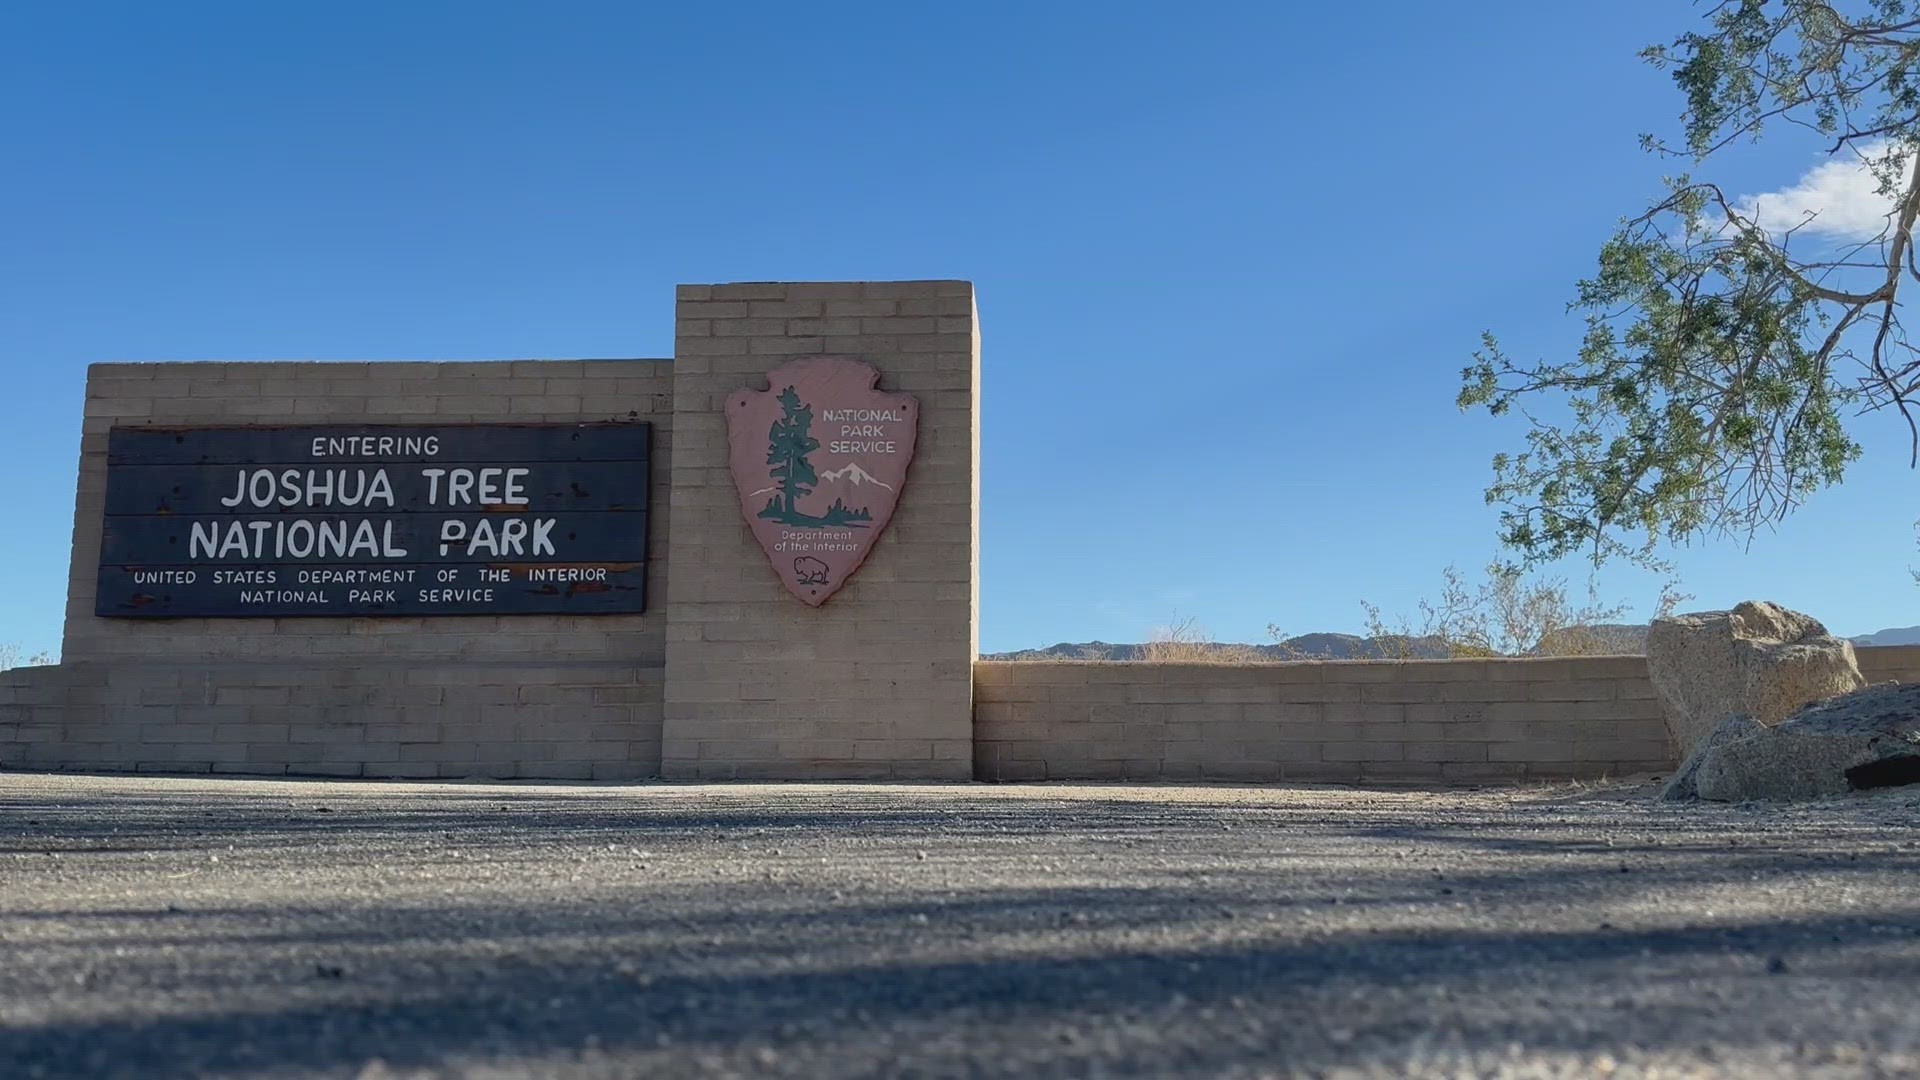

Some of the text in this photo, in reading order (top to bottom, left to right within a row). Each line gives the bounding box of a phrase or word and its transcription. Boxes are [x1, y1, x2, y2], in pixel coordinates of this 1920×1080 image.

[823, 410, 902, 421] NATIONAL
[841, 426, 884, 436] PARK
[311, 436, 439, 456] ENTERING
[830, 441, 896, 453] SERVICE
[221, 469, 529, 507] JOSHUA TREE
[190, 519, 556, 558] NATIONAL PARK
[782, 531, 852, 542] Department
[774, 542, 858, 553] of the Interior
[134, 569, 606, 584] UNITED STATES DEPARTMENT OF THE INTERIOR
[241, 589, 493, 603] NATIONAL PARK SERVICE
